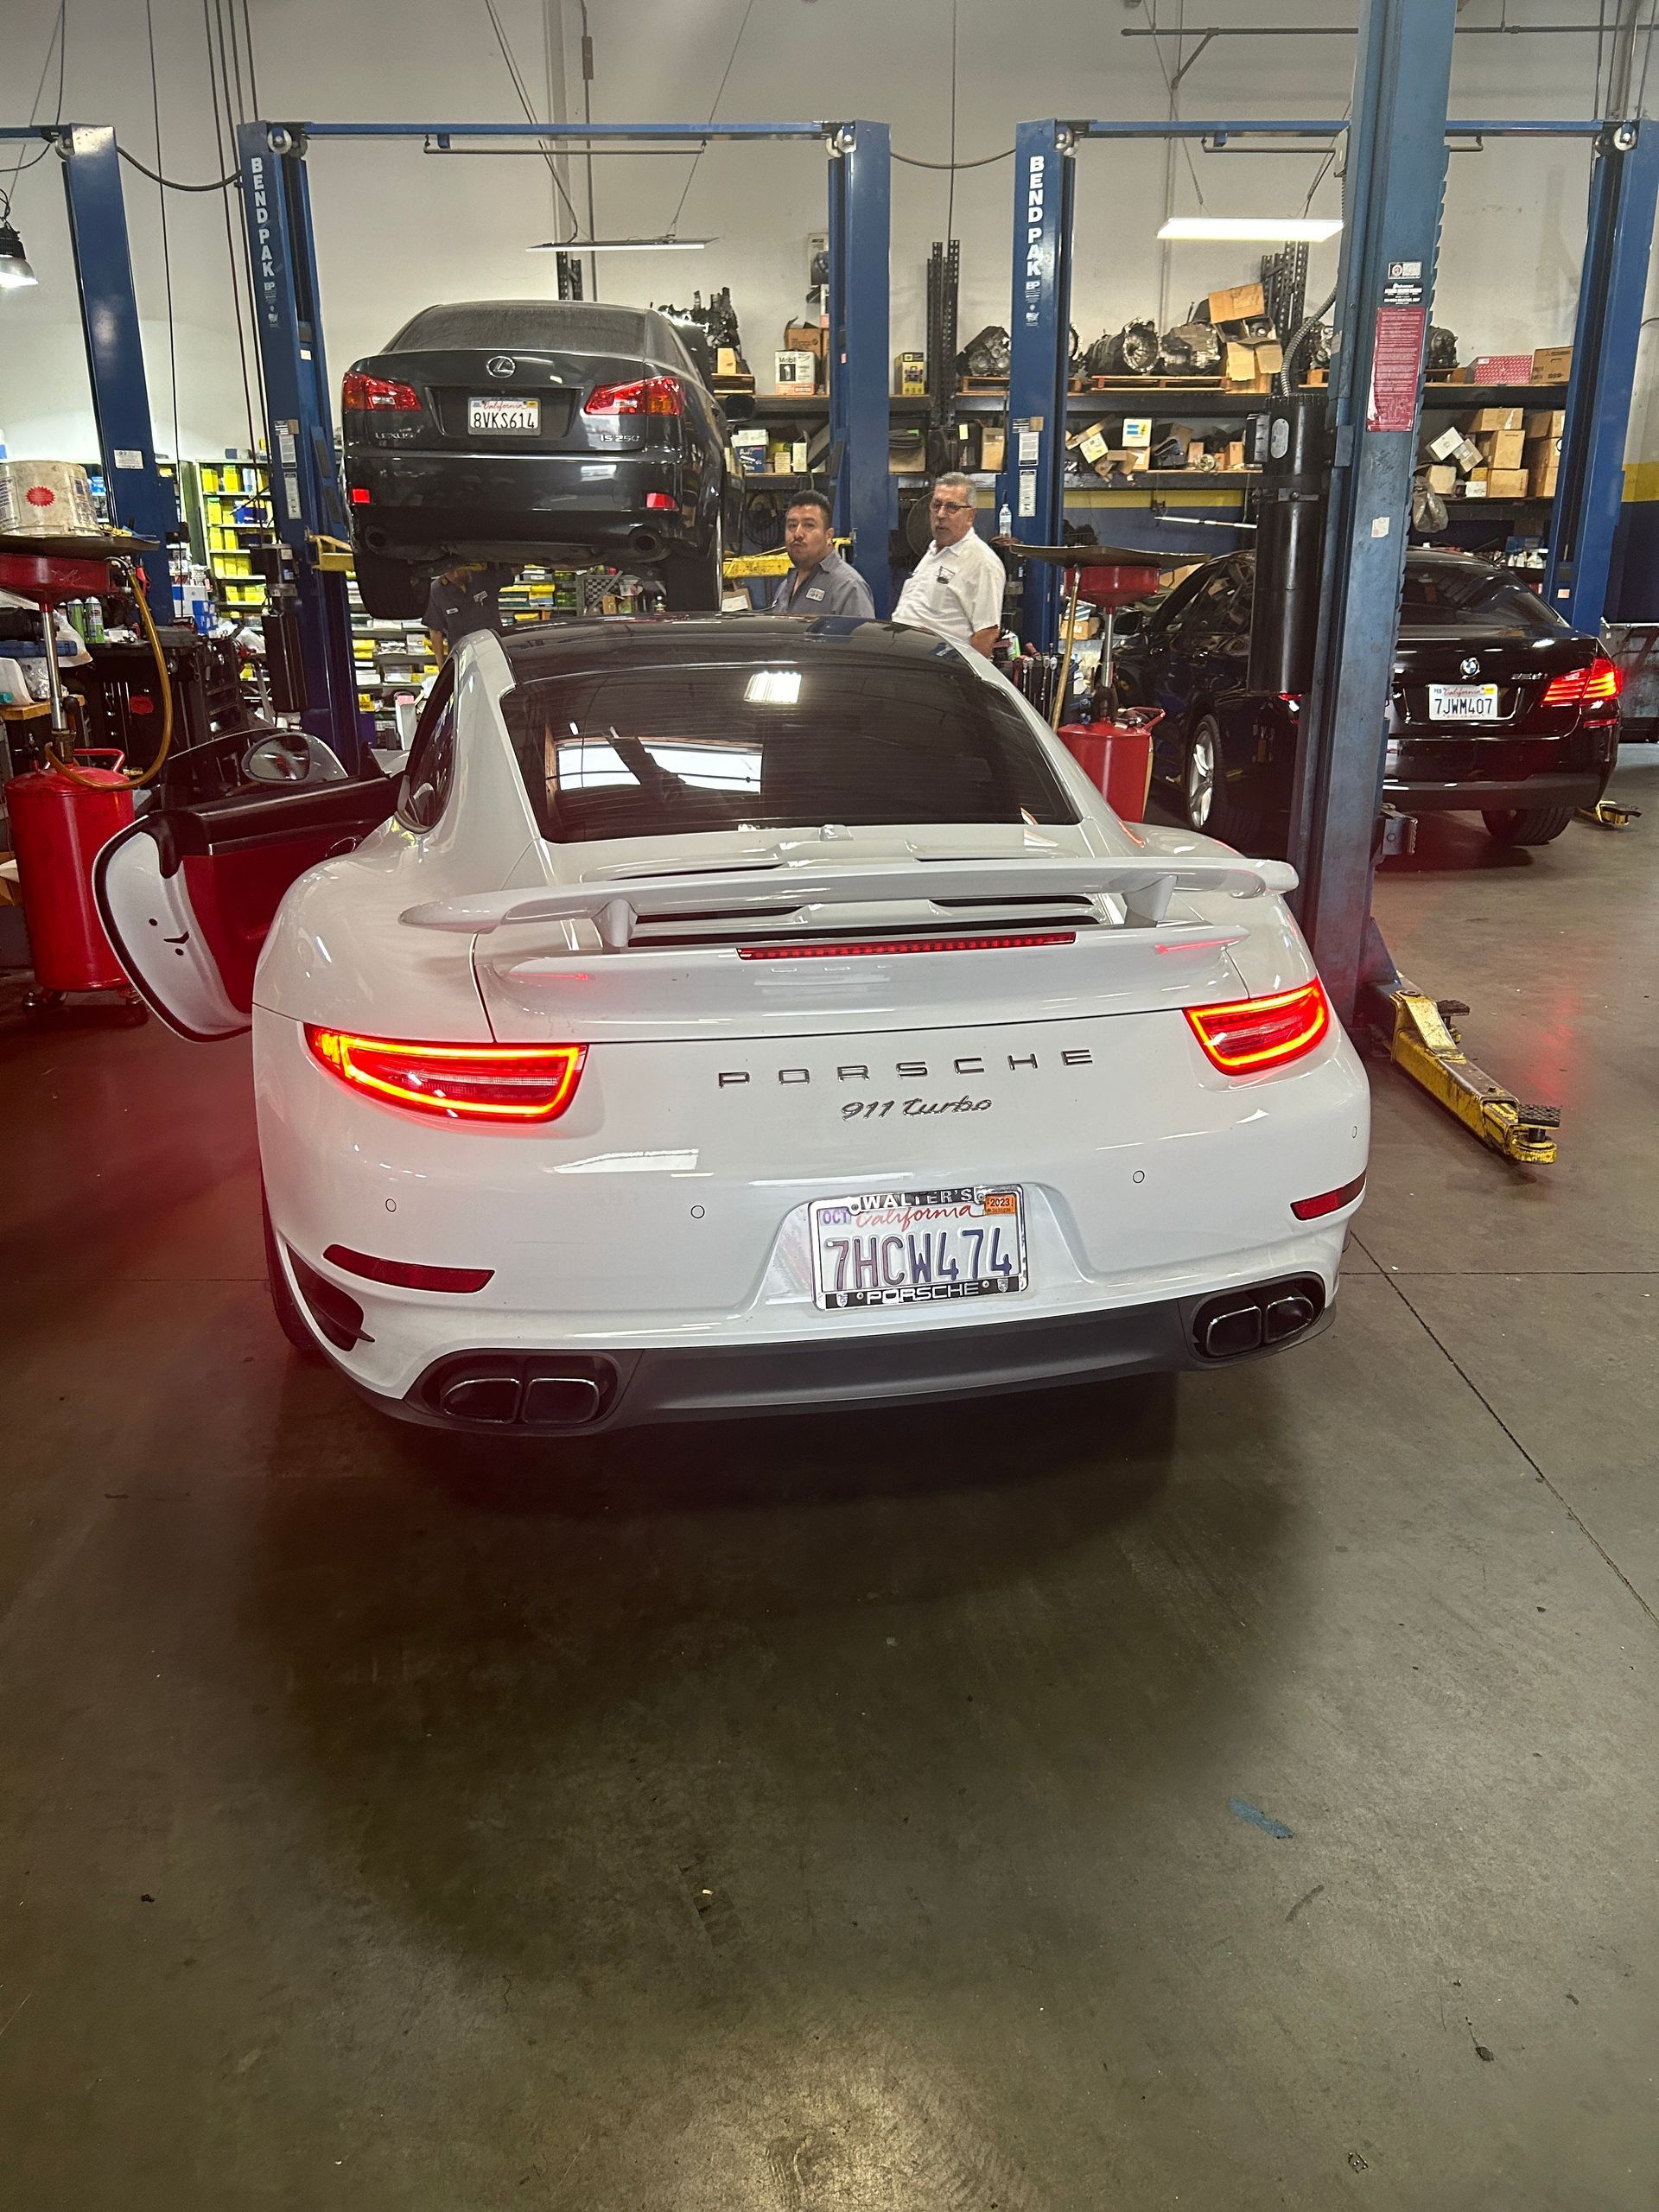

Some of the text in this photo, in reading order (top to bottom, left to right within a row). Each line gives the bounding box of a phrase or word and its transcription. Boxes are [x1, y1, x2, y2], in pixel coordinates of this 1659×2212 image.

[251, 157, 268, 224] BEND
[1028, 156, 1045, 223] BEND
[259, 229, 274, 276] PAK
[484, 401, 525, 411] California
[474, 412, 535, 429] 8VKS614
[1443, 687, 1482, 697] California
[1434, 698, 1492, 715] 7JWM407
[718, 1049, 1093, 1089] PORSCHE
[841, 1095, 993, 1122] 911 turbo
[989, 1198, 1010, 1207] 2023
[823, 1209, 849, 1224] OCT
[855, 1205, 985, 1232] California
[826, 1227, 1013, 1291] 7HCW474
[867, 1281, 979, 1306] PORSCHE
